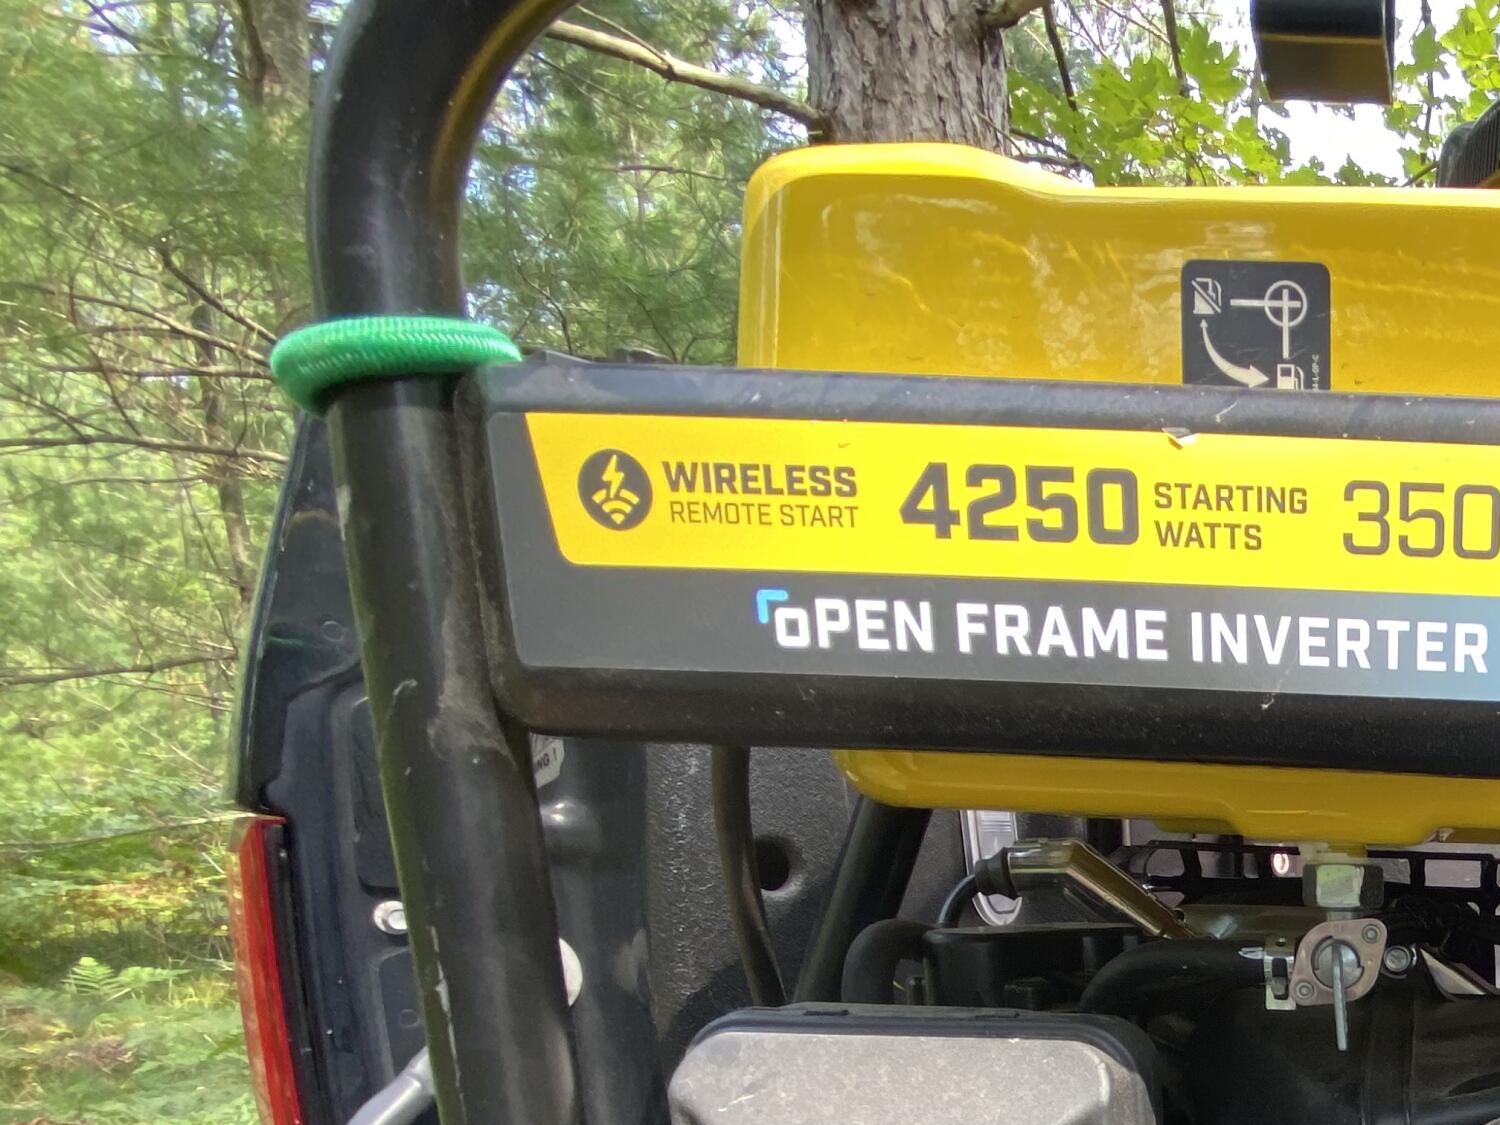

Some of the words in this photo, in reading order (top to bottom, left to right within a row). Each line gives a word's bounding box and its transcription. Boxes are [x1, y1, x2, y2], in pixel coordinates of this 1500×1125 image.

[661, 460, 858, 498] WIRELESS
[669, 502, 773, 527] REMOTE
[780, 503, 859, 529] START
[899, 461, 1140, 546] 4250
[1153, 482, 1308, 515] STARTING
[1154, 521, 1263, 552] WATTS
[957, 602, 1169, 663] FRAME
[1189, 611, 1490, 675] INVERTER
